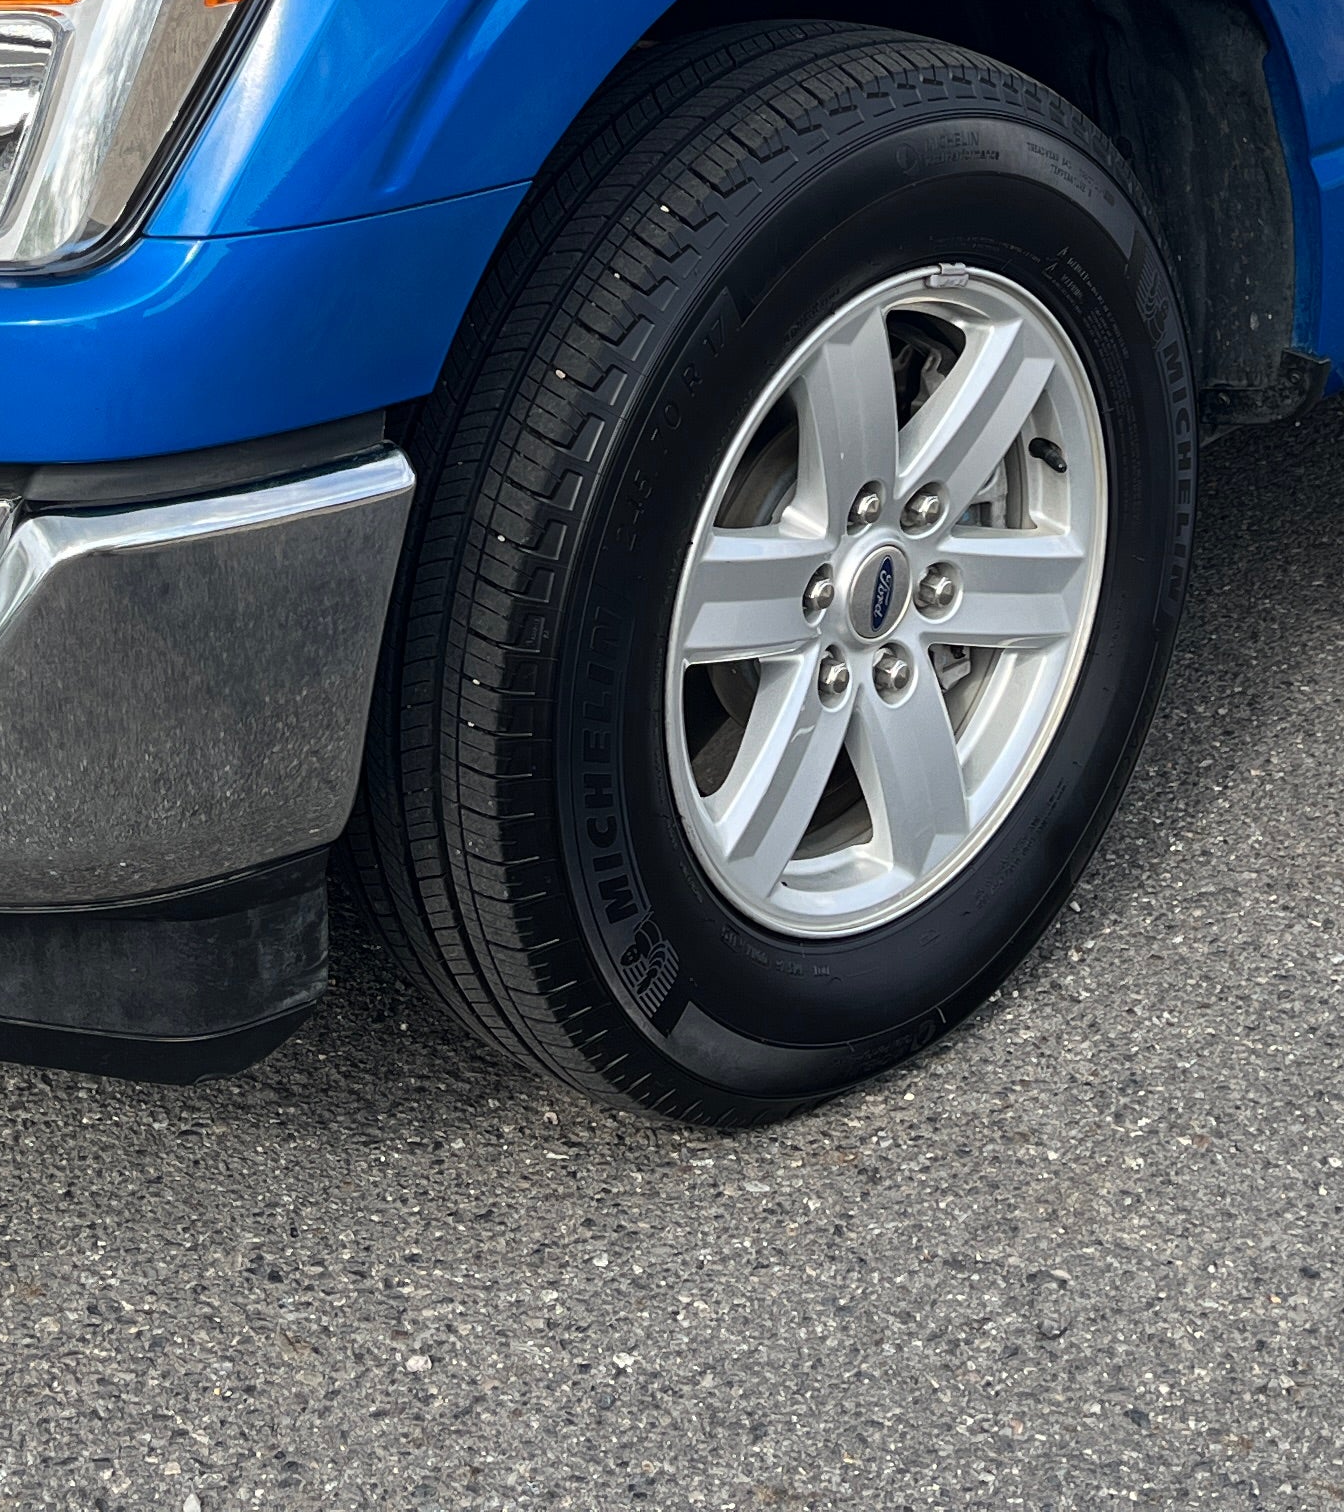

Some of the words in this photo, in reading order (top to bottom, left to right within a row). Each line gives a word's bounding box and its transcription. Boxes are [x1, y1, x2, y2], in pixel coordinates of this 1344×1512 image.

[873, 569, 892, 618] Ford
[1162, 339, 1193, 603] MICHELIN
[582, 605, 640, 925] MICHELIN
